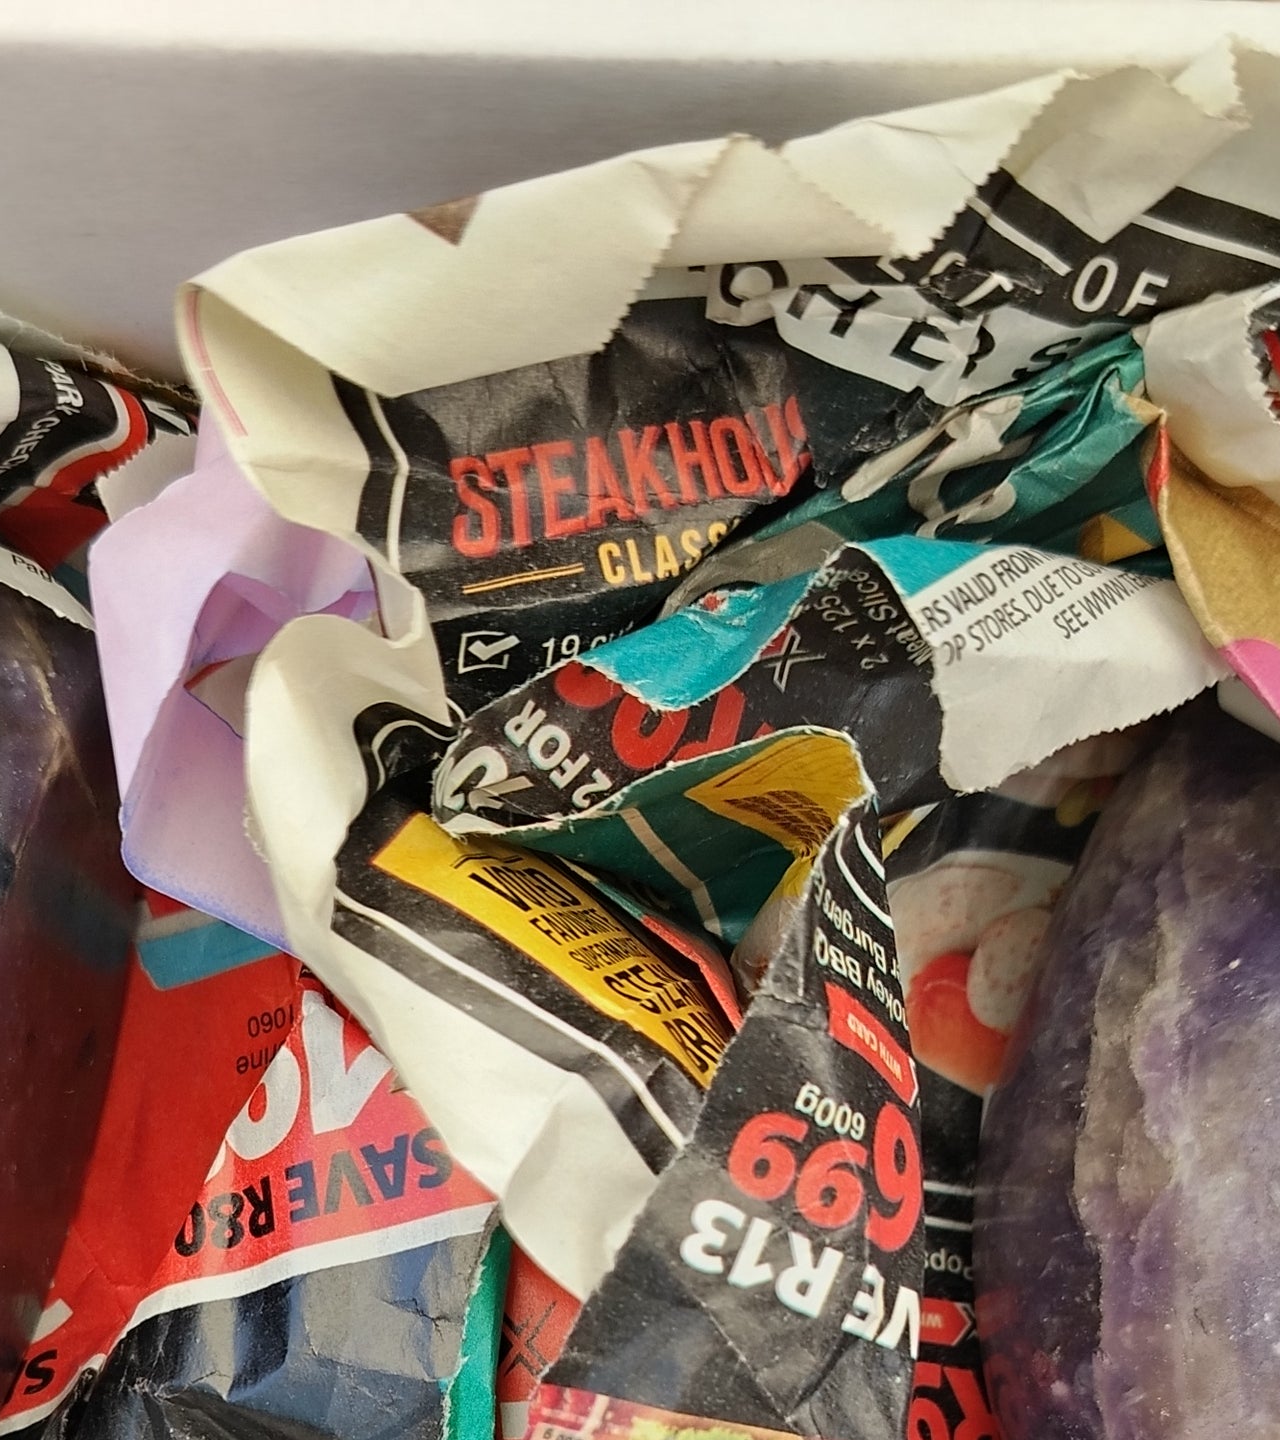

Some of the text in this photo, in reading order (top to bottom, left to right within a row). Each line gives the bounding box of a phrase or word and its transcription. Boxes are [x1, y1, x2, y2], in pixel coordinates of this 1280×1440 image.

[1071, 256, 1170, 318] OF
[450, 395, 817, 558] STEAKHOU
[918, 548, 1047, 636] RS VALID FROM
[1026, 577, 1064, 615] DUE
[1061, 565, 1084, 592] TO
[1053, 605, 1090, 639] SEE
[860, 652, 889, 671] 2
[503, 699, 591, 790] FOR
[573, 768, 612, 809] 2
[468, 865, 582, 914] VOTED
[528, 907, 623, 946] FAVOURITE
[814, 926, 863, 990] BBQ
[822, 888, 888, 975] Burgers
[846, 1012, 904, 1082] WITH CARD
[794, 1080, 866, 1142] 600g
[173, 1126, 454, 1258] SAVE R80
[679, 1199, 844, 1319] R13
